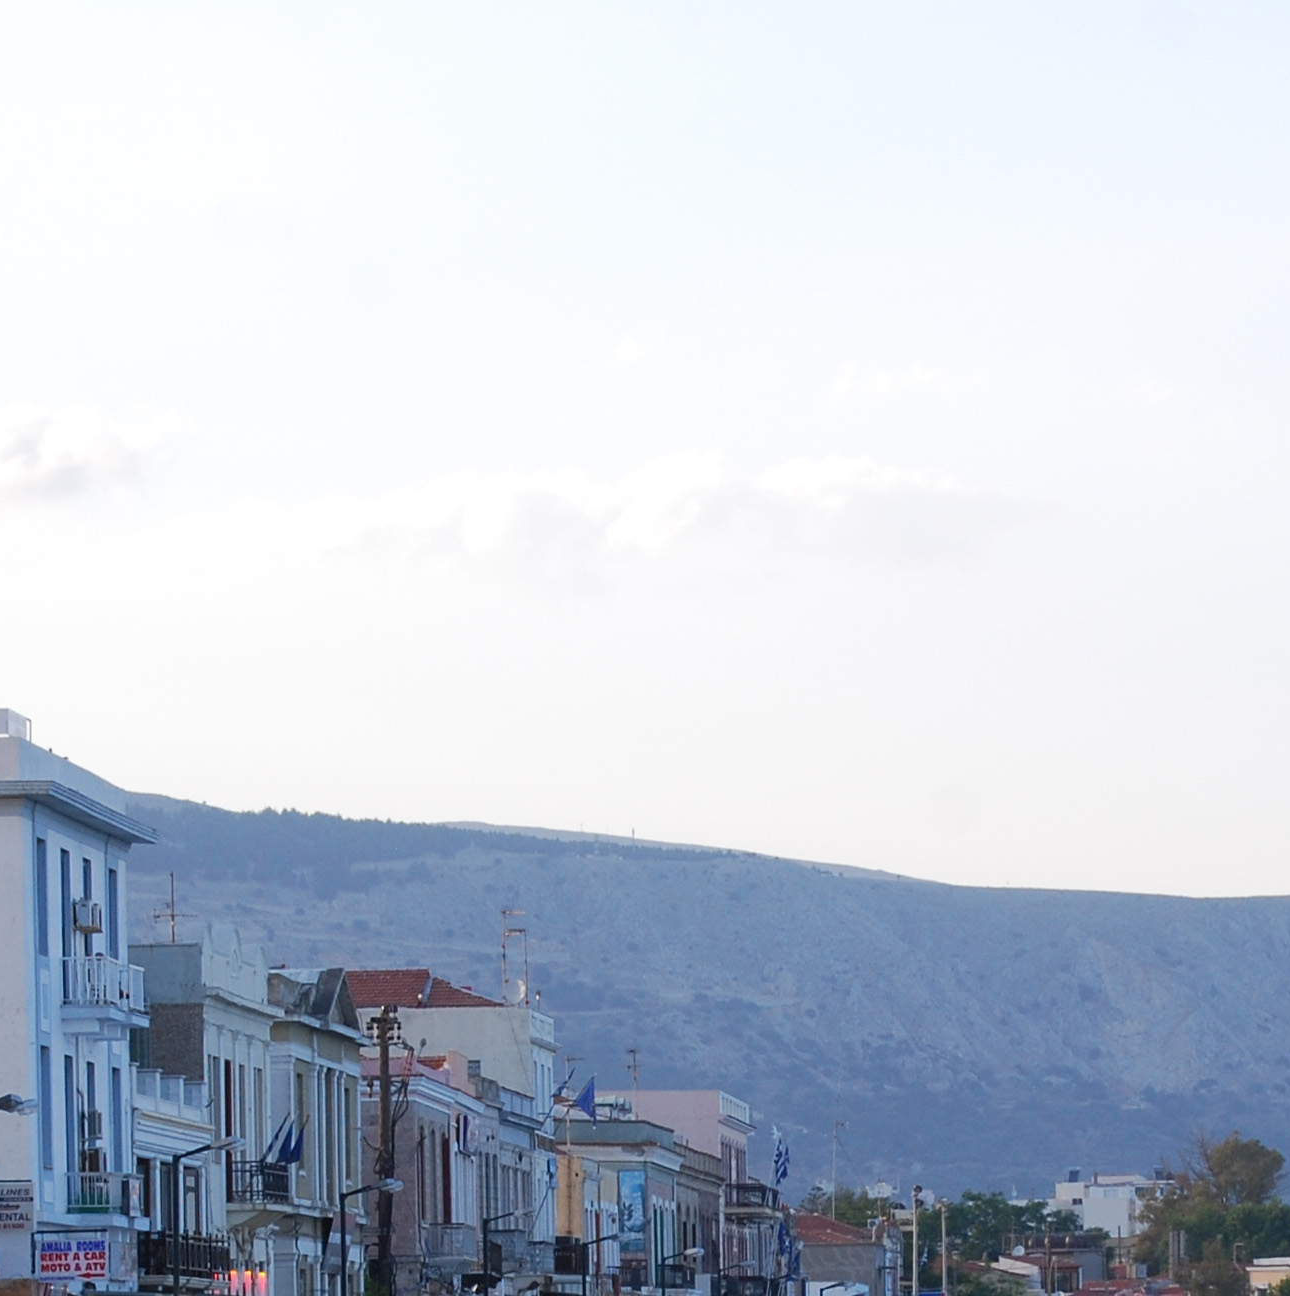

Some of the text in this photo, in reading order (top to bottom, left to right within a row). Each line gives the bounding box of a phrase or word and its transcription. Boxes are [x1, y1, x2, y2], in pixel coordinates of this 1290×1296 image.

[0, 1188, 30, 1196] LINES
[41, 1241, 106, 1252] AMALIA ROOMS
[40, 1251, 106, 1262] RENT A CAR
[40, 1262, 106, 1273] MOTO & ATV
